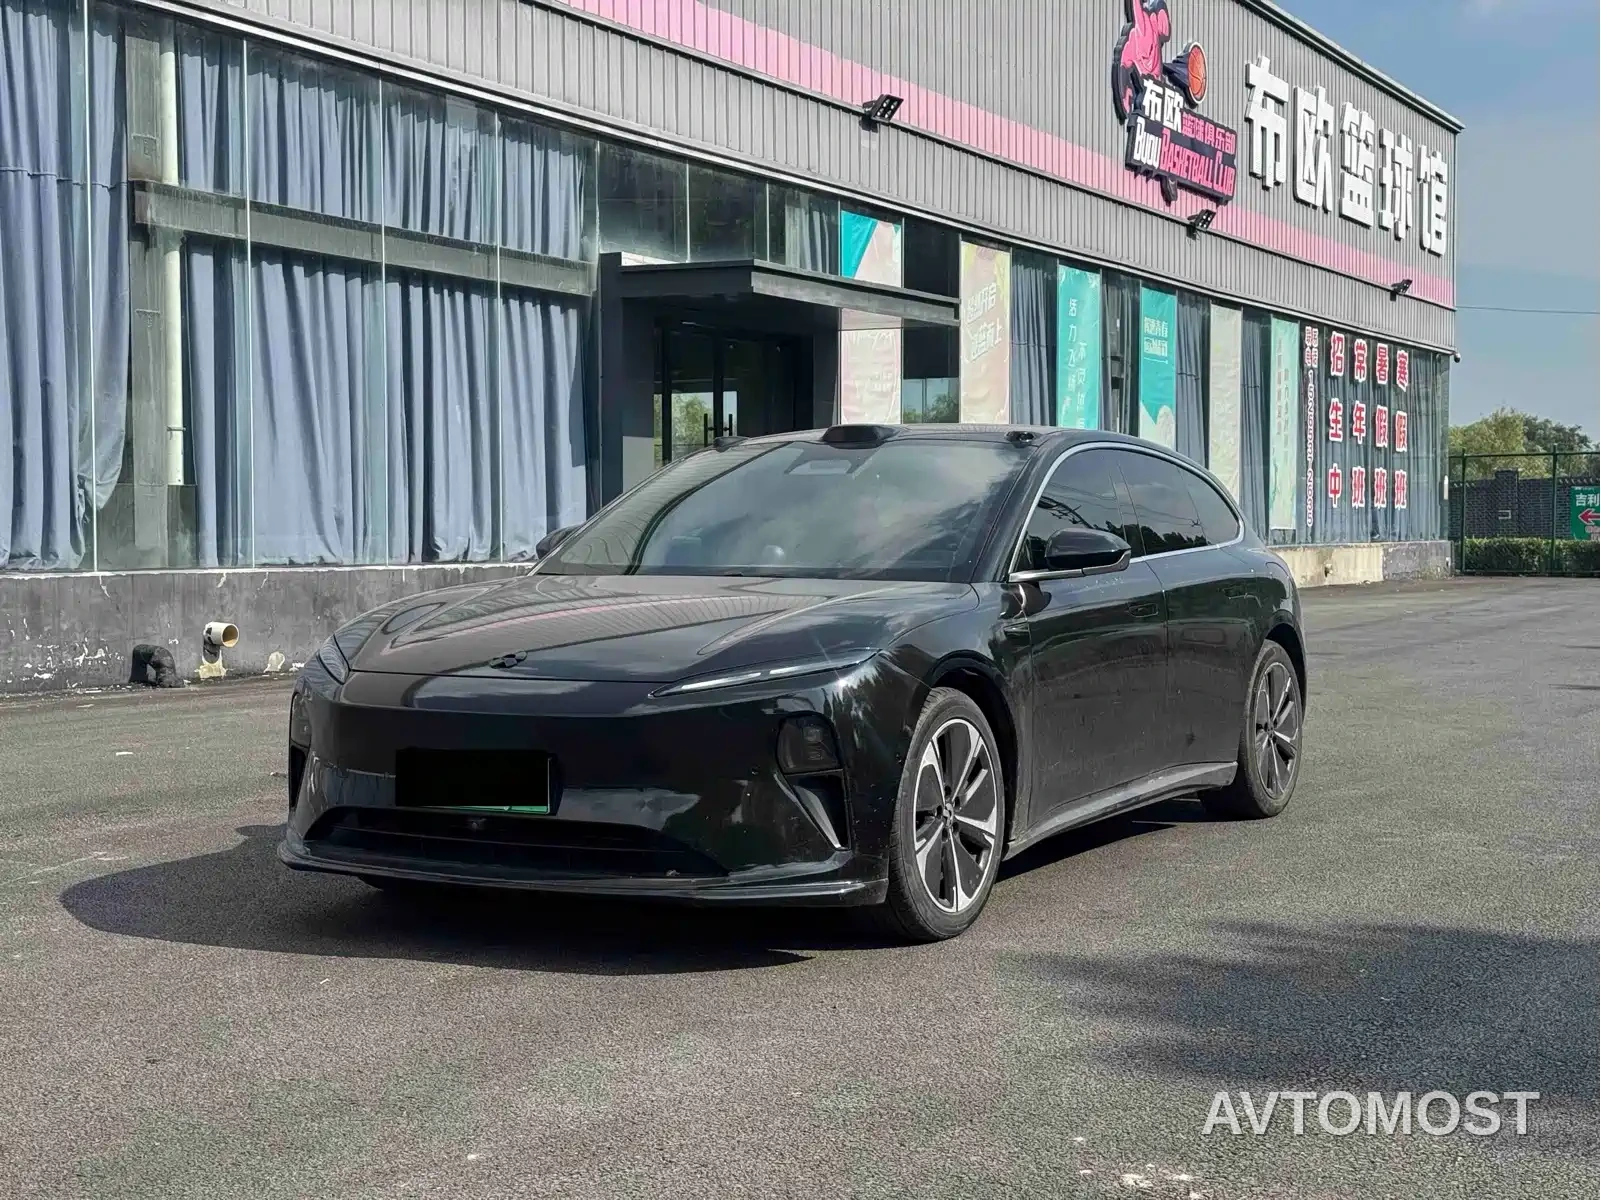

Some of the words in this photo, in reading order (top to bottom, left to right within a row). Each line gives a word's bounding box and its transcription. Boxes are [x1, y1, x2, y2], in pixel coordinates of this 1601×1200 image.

[1143, 78, 1184, 133] 布欧
[1181, 111, 1236, 155] 篮球俱乐部
[1246, 56, 1447, 256] 布欧篮球馆
[1328, 330, 1345, 508] 招生中
[1352, 338, 1368, 509] 常年班
[1373, 342, 1389, 509] 暑假班
[1395, 349, 1408, 510] 寒假班
